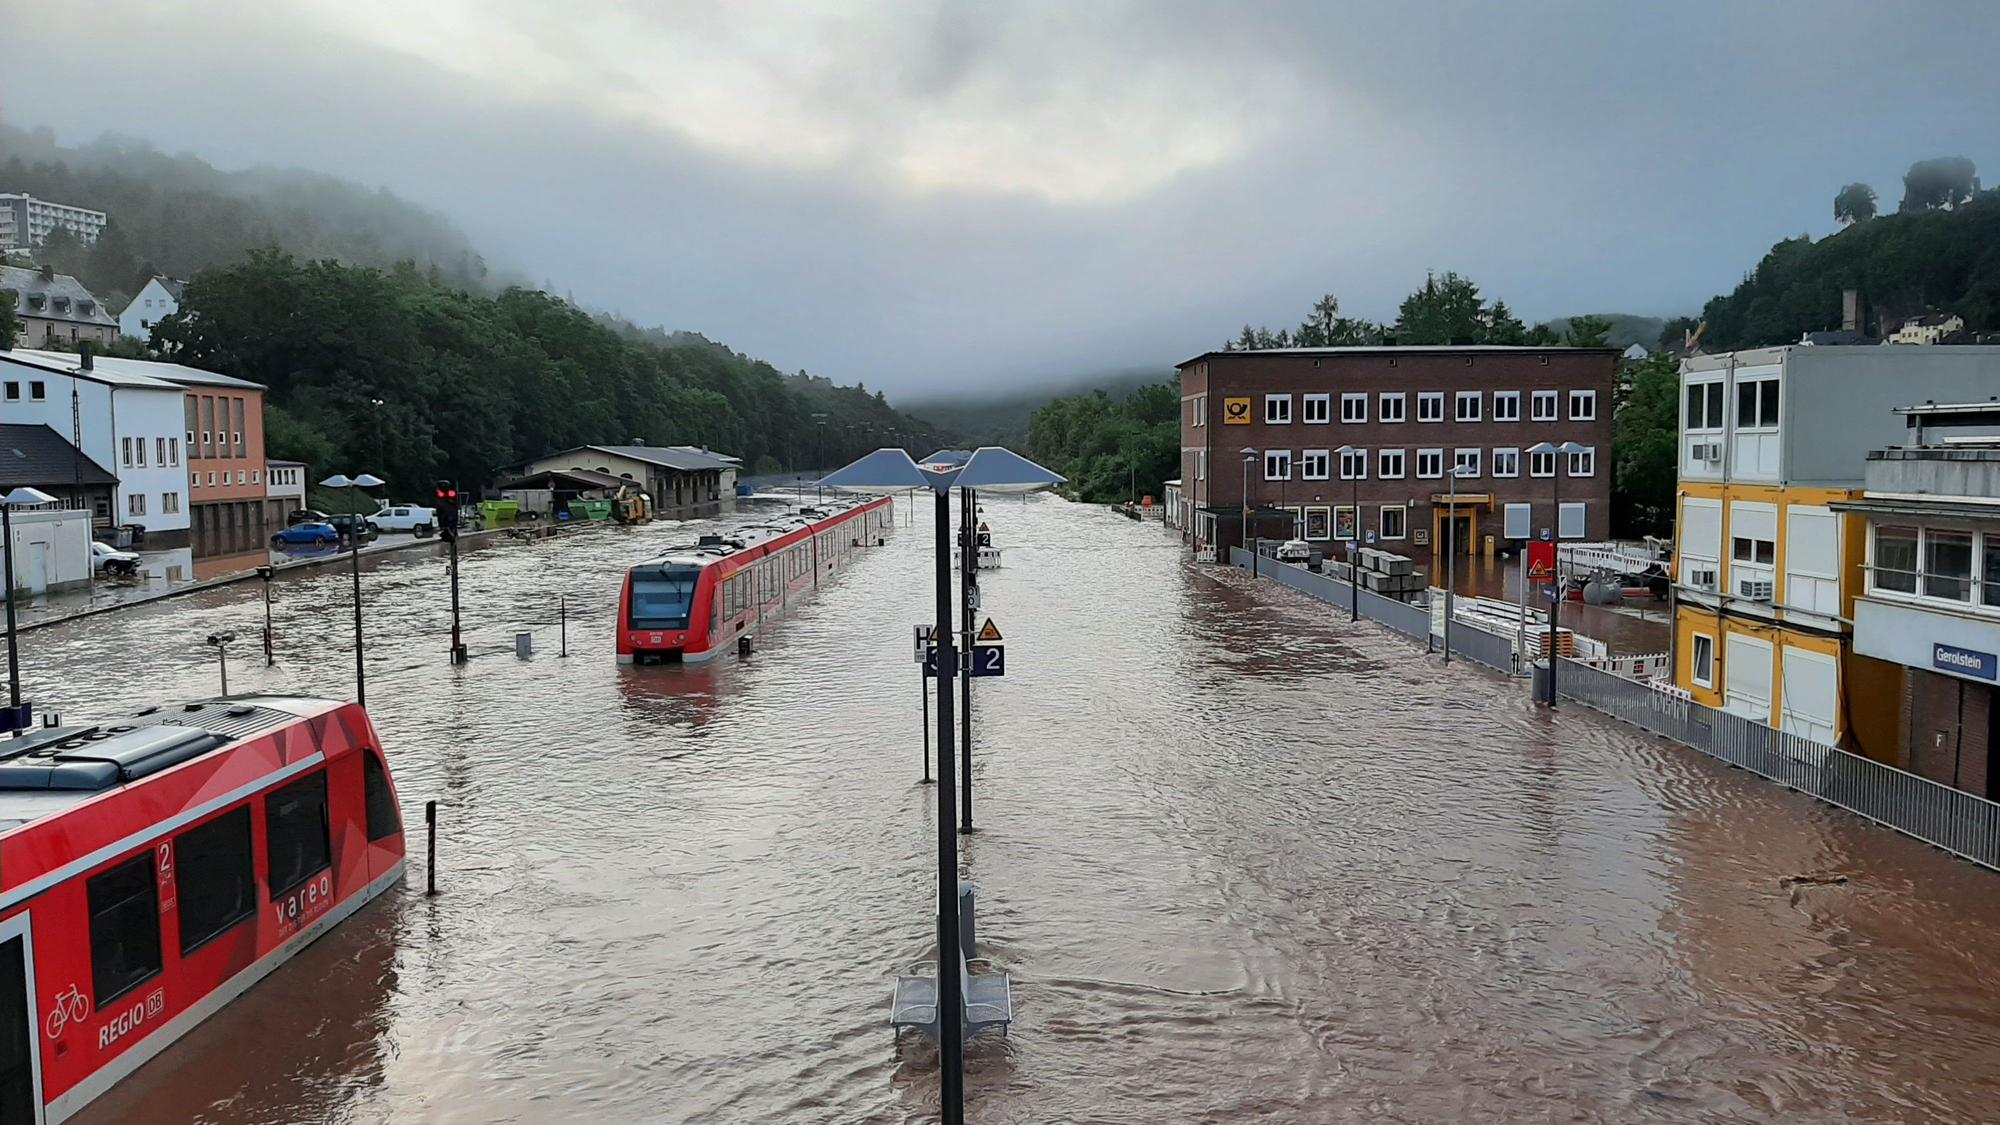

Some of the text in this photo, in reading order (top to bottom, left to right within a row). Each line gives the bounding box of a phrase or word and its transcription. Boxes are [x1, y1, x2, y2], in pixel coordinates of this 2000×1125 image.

[916, 627, 930, 650] H
[986, 648, 1000, 670] 2
[1936, 648, 1981, 669] Gerolstein
[160, 843, 171, 872] 2
[276, 876, 328, 925] vareo
[98, 991, 163, 1050] REGIO DB
